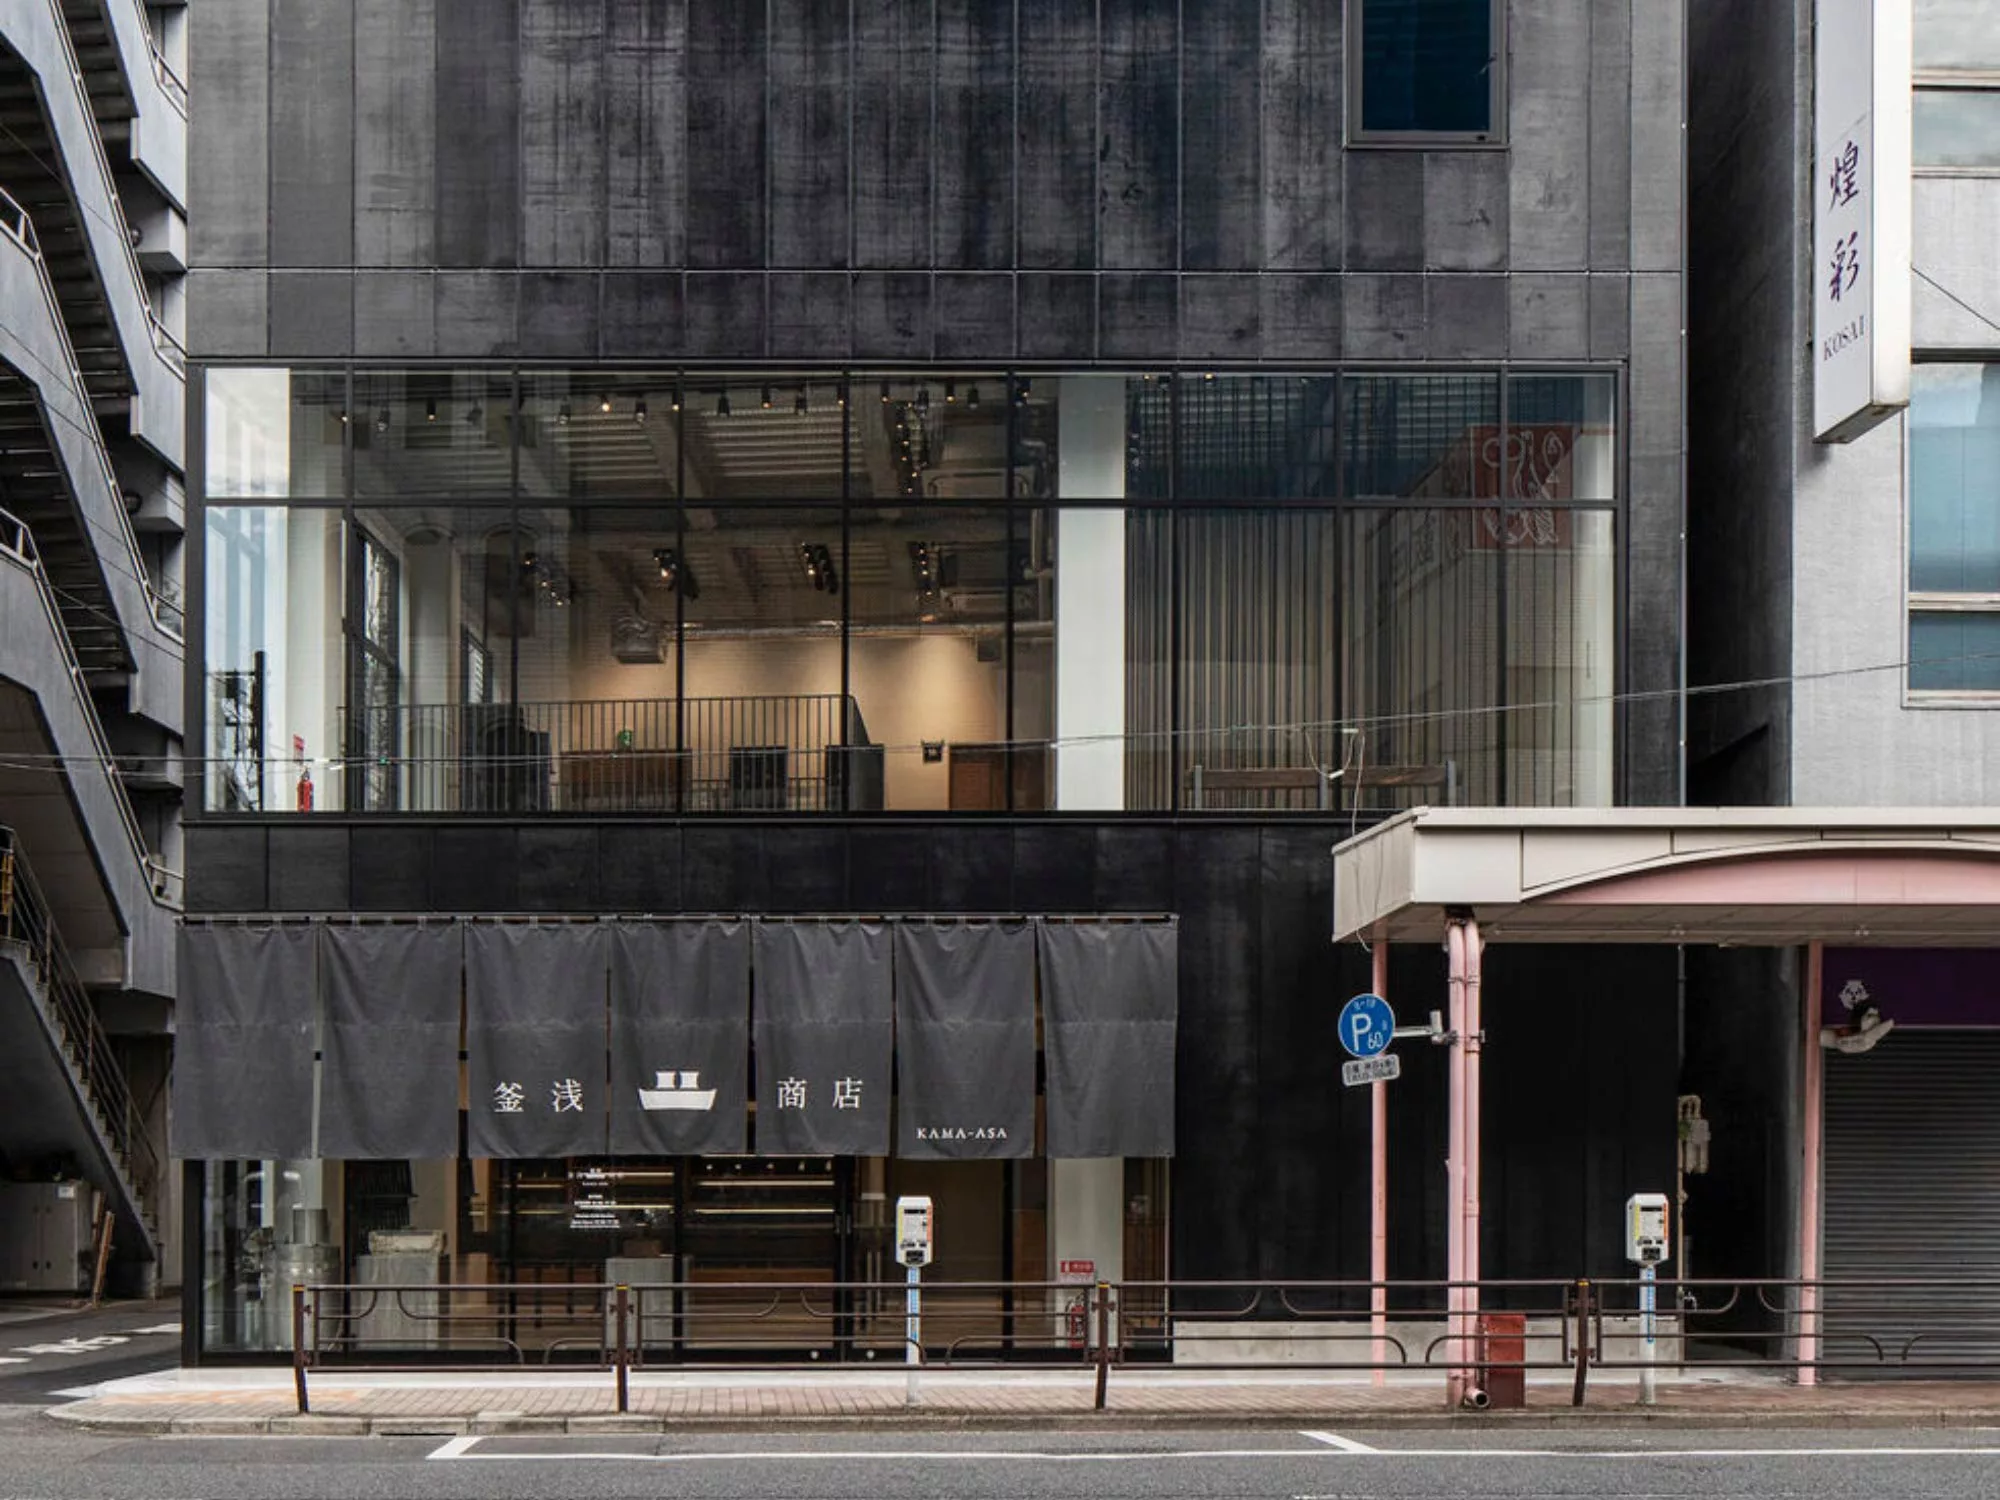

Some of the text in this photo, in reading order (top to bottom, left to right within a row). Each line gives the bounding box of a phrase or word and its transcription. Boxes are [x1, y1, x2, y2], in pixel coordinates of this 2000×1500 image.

[1828, 140, 1860, 302] 煌彩
[1823, 315, 1865, 362] KOSAI
[1352, 1013, 1372, 1052] P
[1367, 1031, 1384, 1050] 60
[493, 1077, 864, 1113] 釜浅 商店
[915, 1126, 1009, 1140] KAMA-ASA
